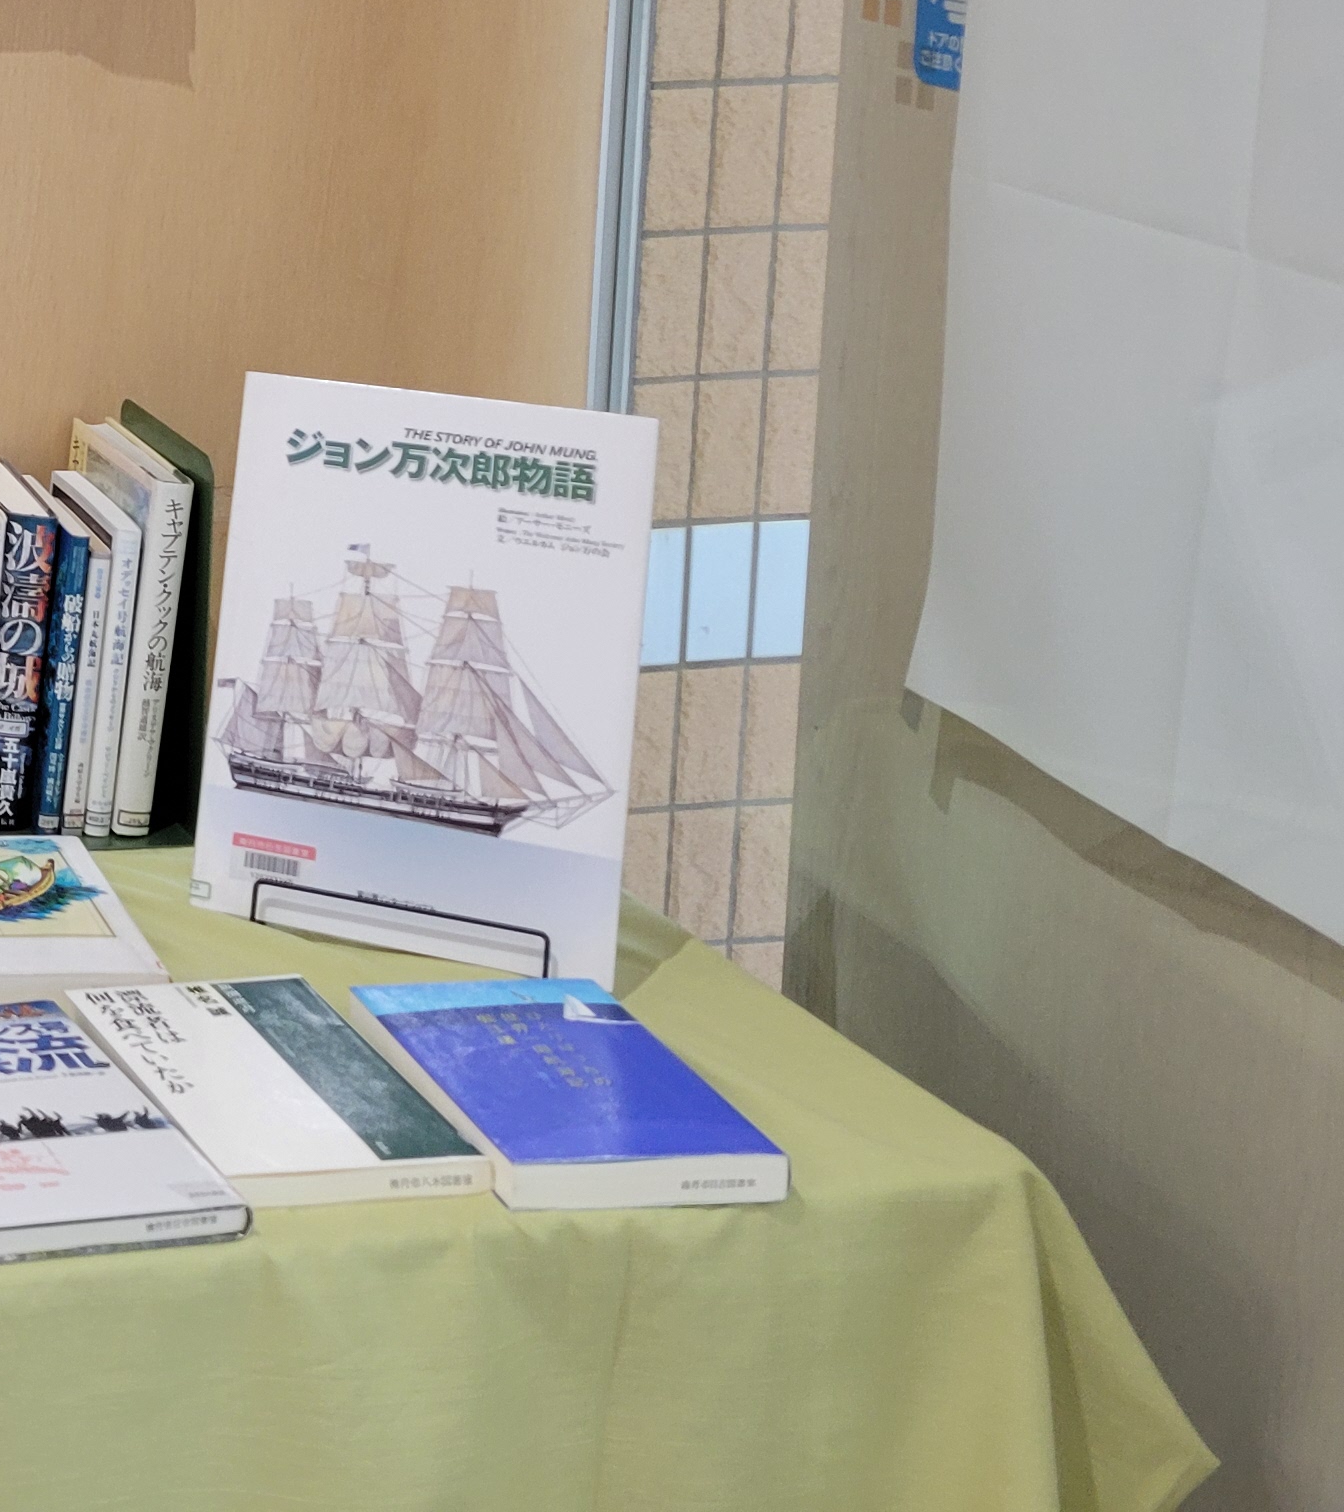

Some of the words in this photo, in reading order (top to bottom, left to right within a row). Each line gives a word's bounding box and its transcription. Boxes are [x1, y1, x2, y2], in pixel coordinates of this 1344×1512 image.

[285, 428, 598, 505] ジョン万次郎物語
[403, 426, 433, 442] THE
[433, 429, 481, 448] STORY
[483, 436, 504, 450] OF
[504, 438, 548, 455] JOHN
[142, 498, 185, 693] キャプテン・クックの航海
[84, 990, 195, 1095] 何を食べていたか
[115, 989, 186, 1045] 漂流者は
